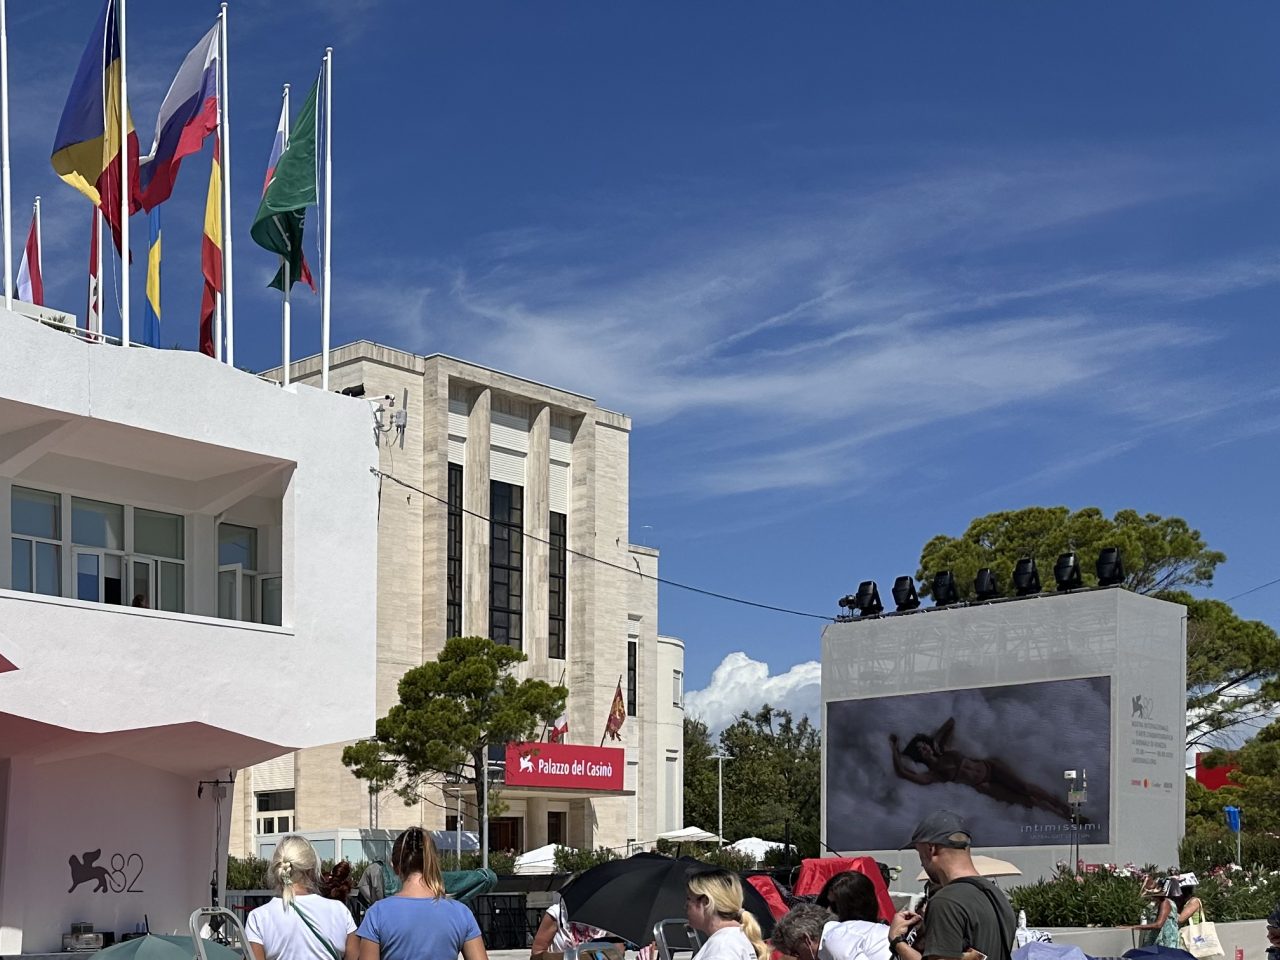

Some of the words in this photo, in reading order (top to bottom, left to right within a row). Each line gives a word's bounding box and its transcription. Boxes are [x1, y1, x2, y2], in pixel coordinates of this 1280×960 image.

[538, 757, 569, 775] Palazzo
[571, 759, 585, 776] del
[586, 761, 613, 777] Casinò
[1020, 823, 1101, 833] intimissimi
[109, 853, 144, 893] 82
